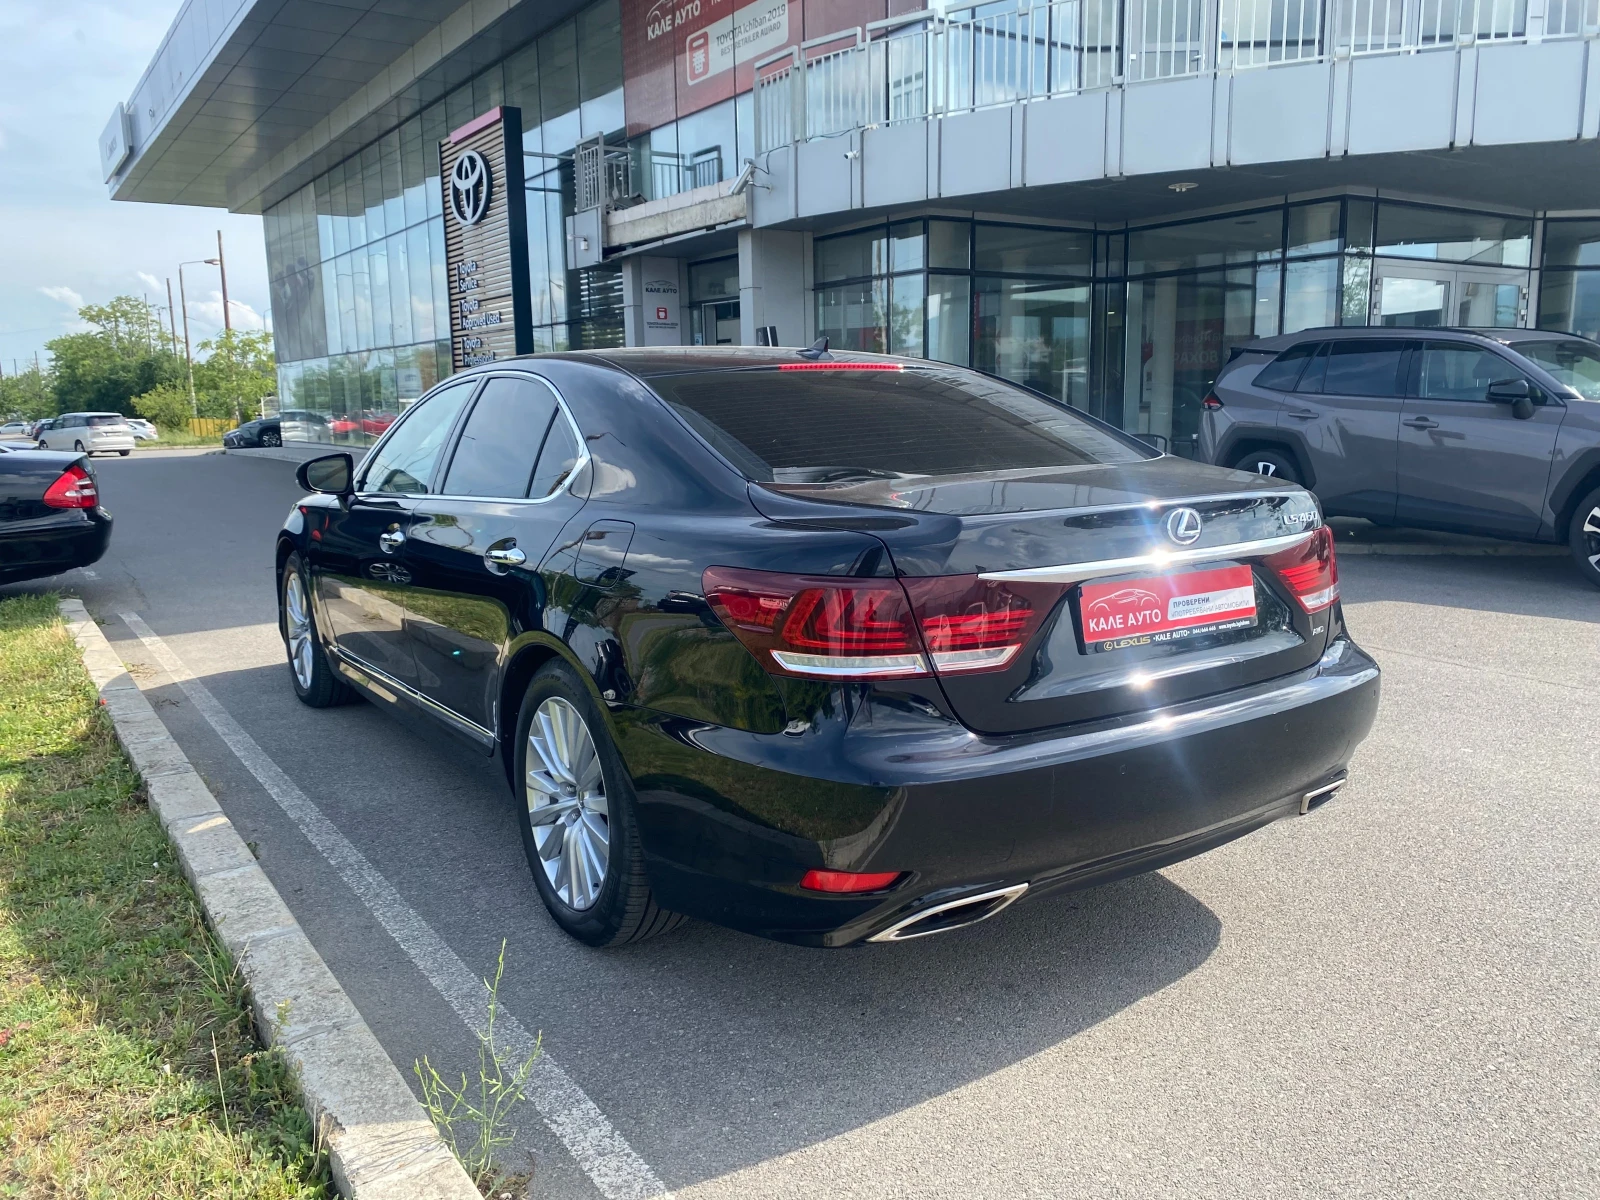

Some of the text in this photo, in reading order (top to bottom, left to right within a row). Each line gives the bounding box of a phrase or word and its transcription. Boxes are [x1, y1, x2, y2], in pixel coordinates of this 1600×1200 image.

[647, 0, 701, 41] КАЛЕ АУТО
[716, 28, 743, 47] TOYOTA
[767, 4, 786, 23] 2019
[720, 44, 734, 57] BEST
[760, 21, 781, 38] AWARD
[459, 262, 477, 275] Toyota
[459, 279, 478, 291] Service
[460, 299, 479, 313] Toyota
[463, 312, 500, 330] Approved Used
[463, 337, 482, 351] Toyota
[464, 352, 495, 367] Professional
[1173, 597, 1211, 609] ПРОВЕРЕНИ
[1089, 608, 1162, 633] КАЛЕ АУТО
[1114, 635, 1151, 650] LEXUS
